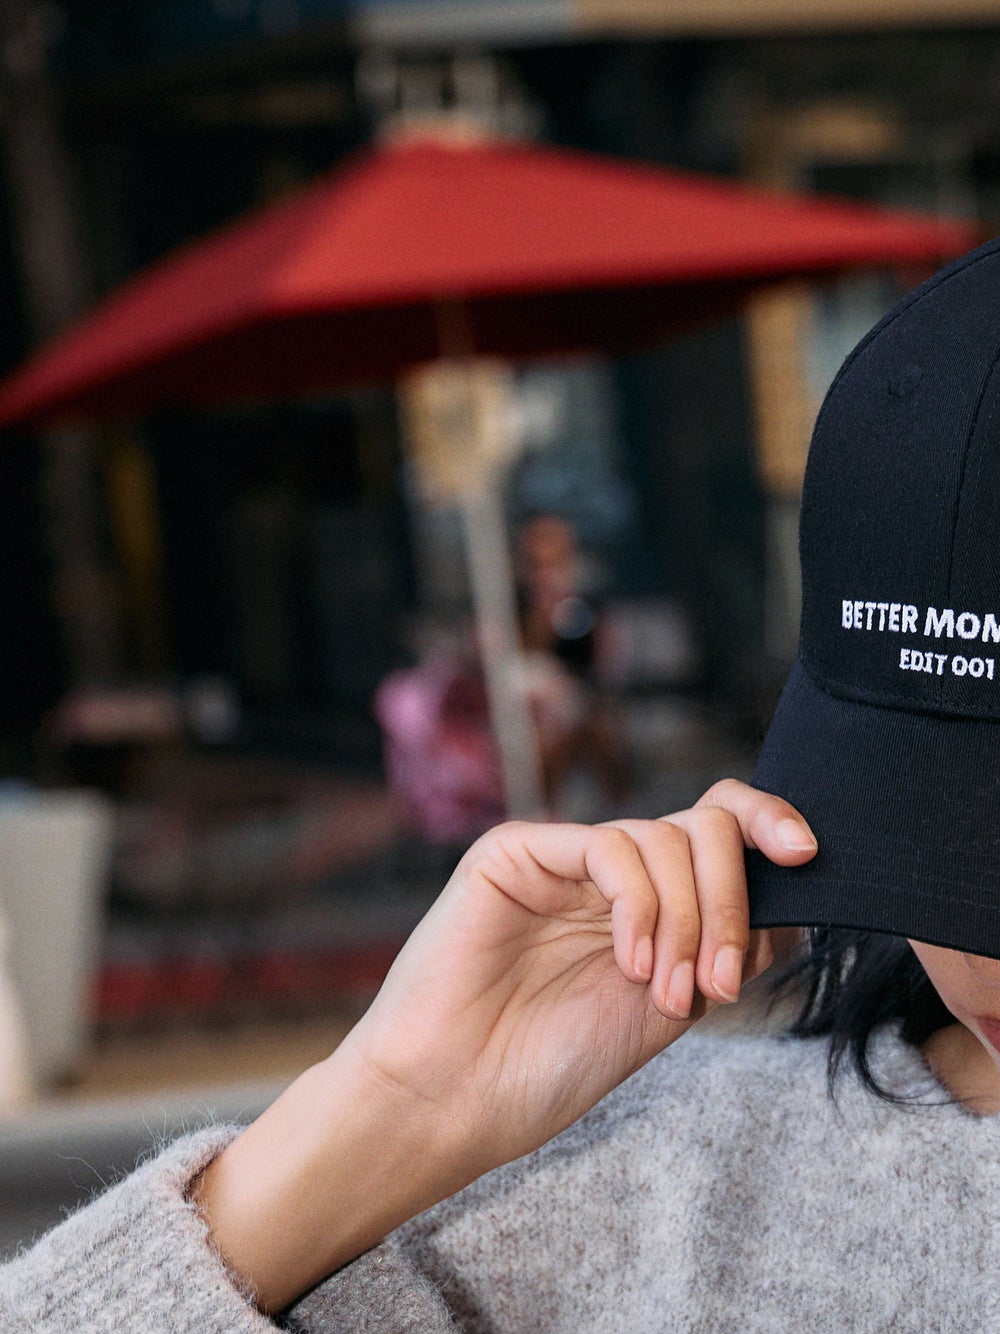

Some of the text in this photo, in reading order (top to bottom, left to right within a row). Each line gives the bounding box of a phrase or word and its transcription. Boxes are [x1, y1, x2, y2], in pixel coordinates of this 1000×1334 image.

[841, 599, 918, 634] BETTER
[898, 648, 995, 681] EDIT 001
